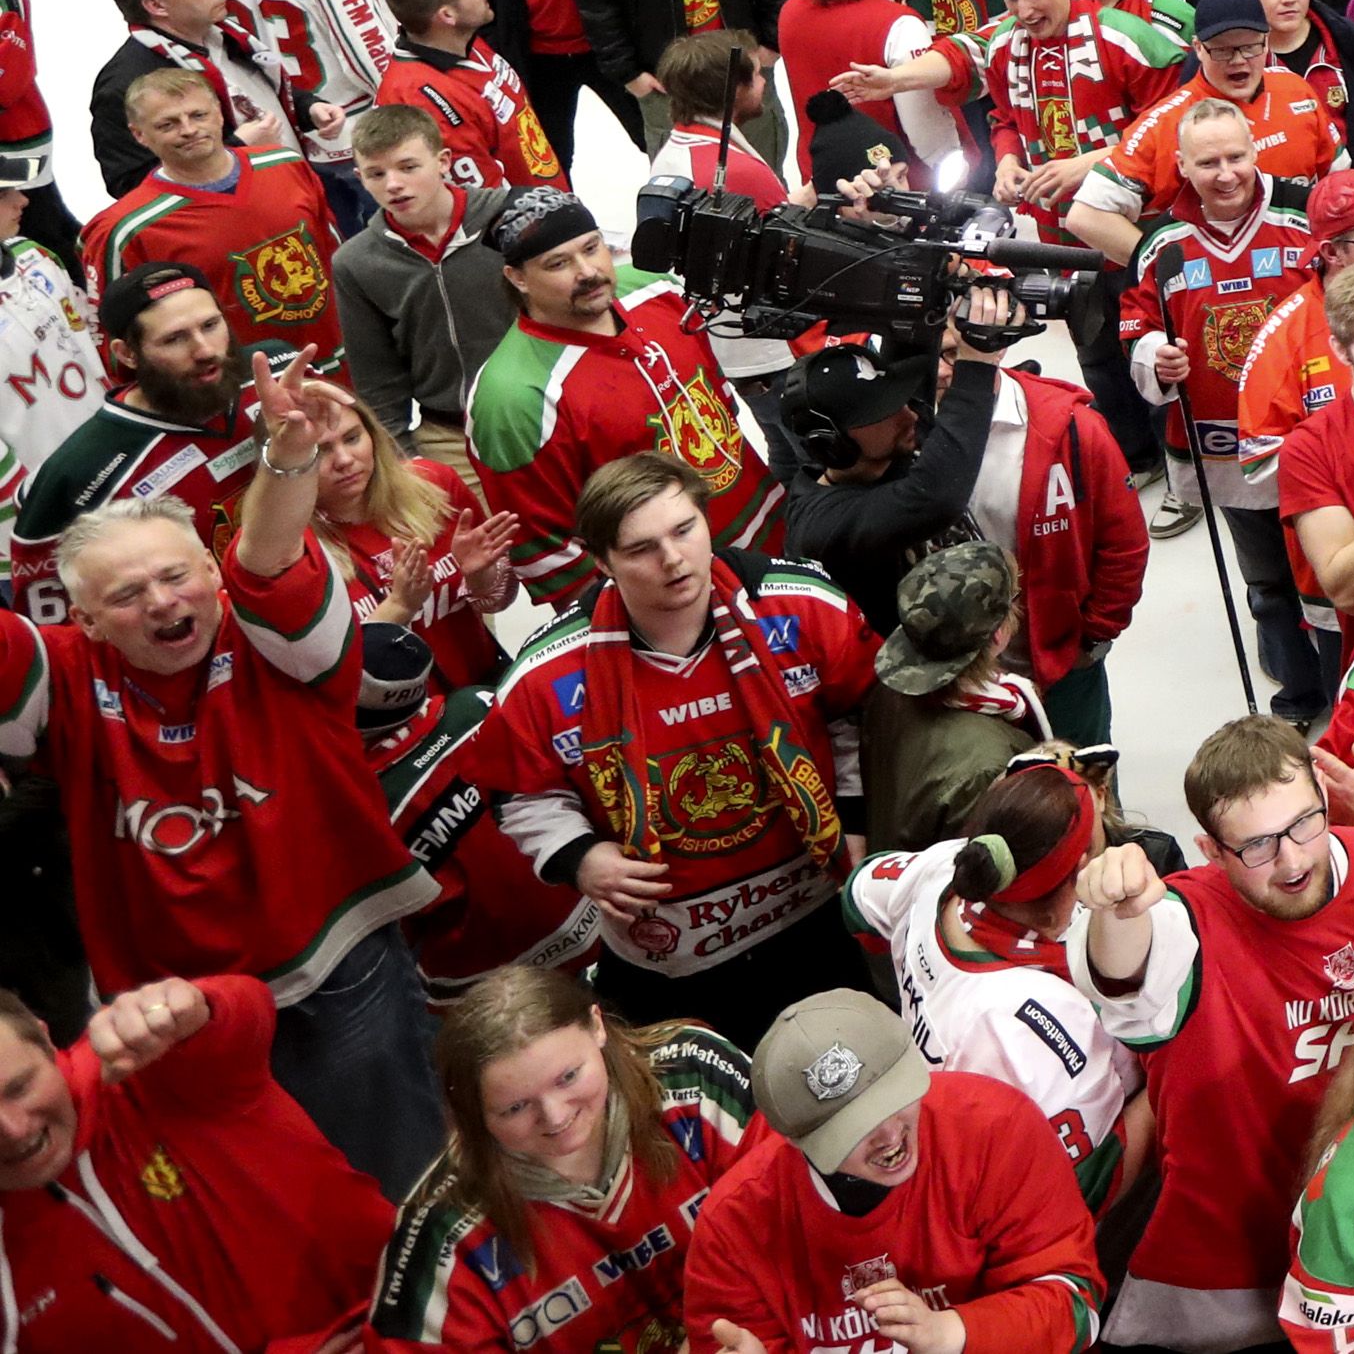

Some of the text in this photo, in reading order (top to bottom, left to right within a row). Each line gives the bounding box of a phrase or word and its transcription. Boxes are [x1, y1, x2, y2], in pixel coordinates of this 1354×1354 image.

[1124, 105, 1170, 156] Mattsson
[1253, 130, 1288, 152] WIBE
[240, 277, 267, 311] MORA
[1220, 279, 1249, 293] WIBE
[1239, 292, 1305, 391] FM Mattsson
[658, 691, 734, 727] WIBE
[413, 732, 454, 769] Reebok
[677, 814, 766, 852] ISHOCKEY
[917, 943, 935, 982] CCM
[1023, 1003, 1070, 1058] Mattsson
[1286, 997, 1313, 1030] NU
[649, 1041, 751, 1090] FM Mattsson
[395, 1172, 459, 1271] Mattsson
[594, 1227, 674, 1282] WIBE
[832, 1307, 882, 1341] KÖR
